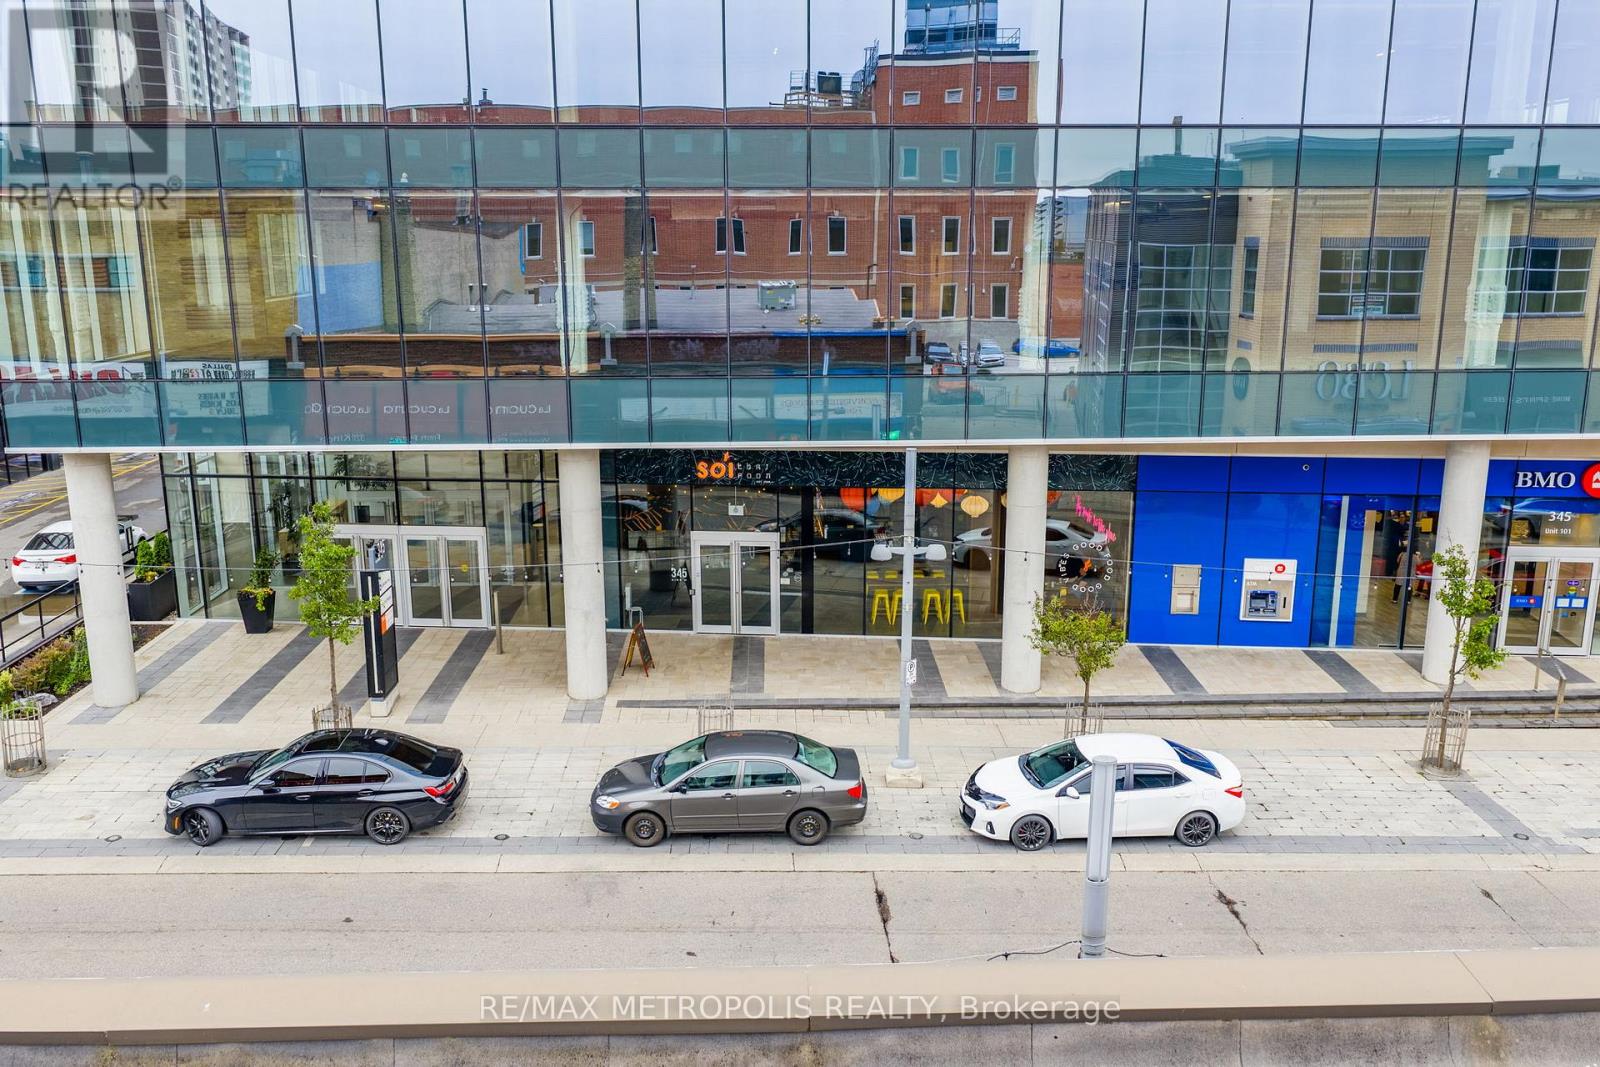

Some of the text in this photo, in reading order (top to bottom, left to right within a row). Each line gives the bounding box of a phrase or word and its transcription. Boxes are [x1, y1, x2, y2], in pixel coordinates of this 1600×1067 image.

[1515, 471, 1576, 488] BMO
[1548, 511, 1572, 522] 345
[1544, 527, 1572, 535] Unit 101
[671, 567, 688, 578] 345
[1059, 541, 1114, 593] GOOD FOOD GOOD VIBES
